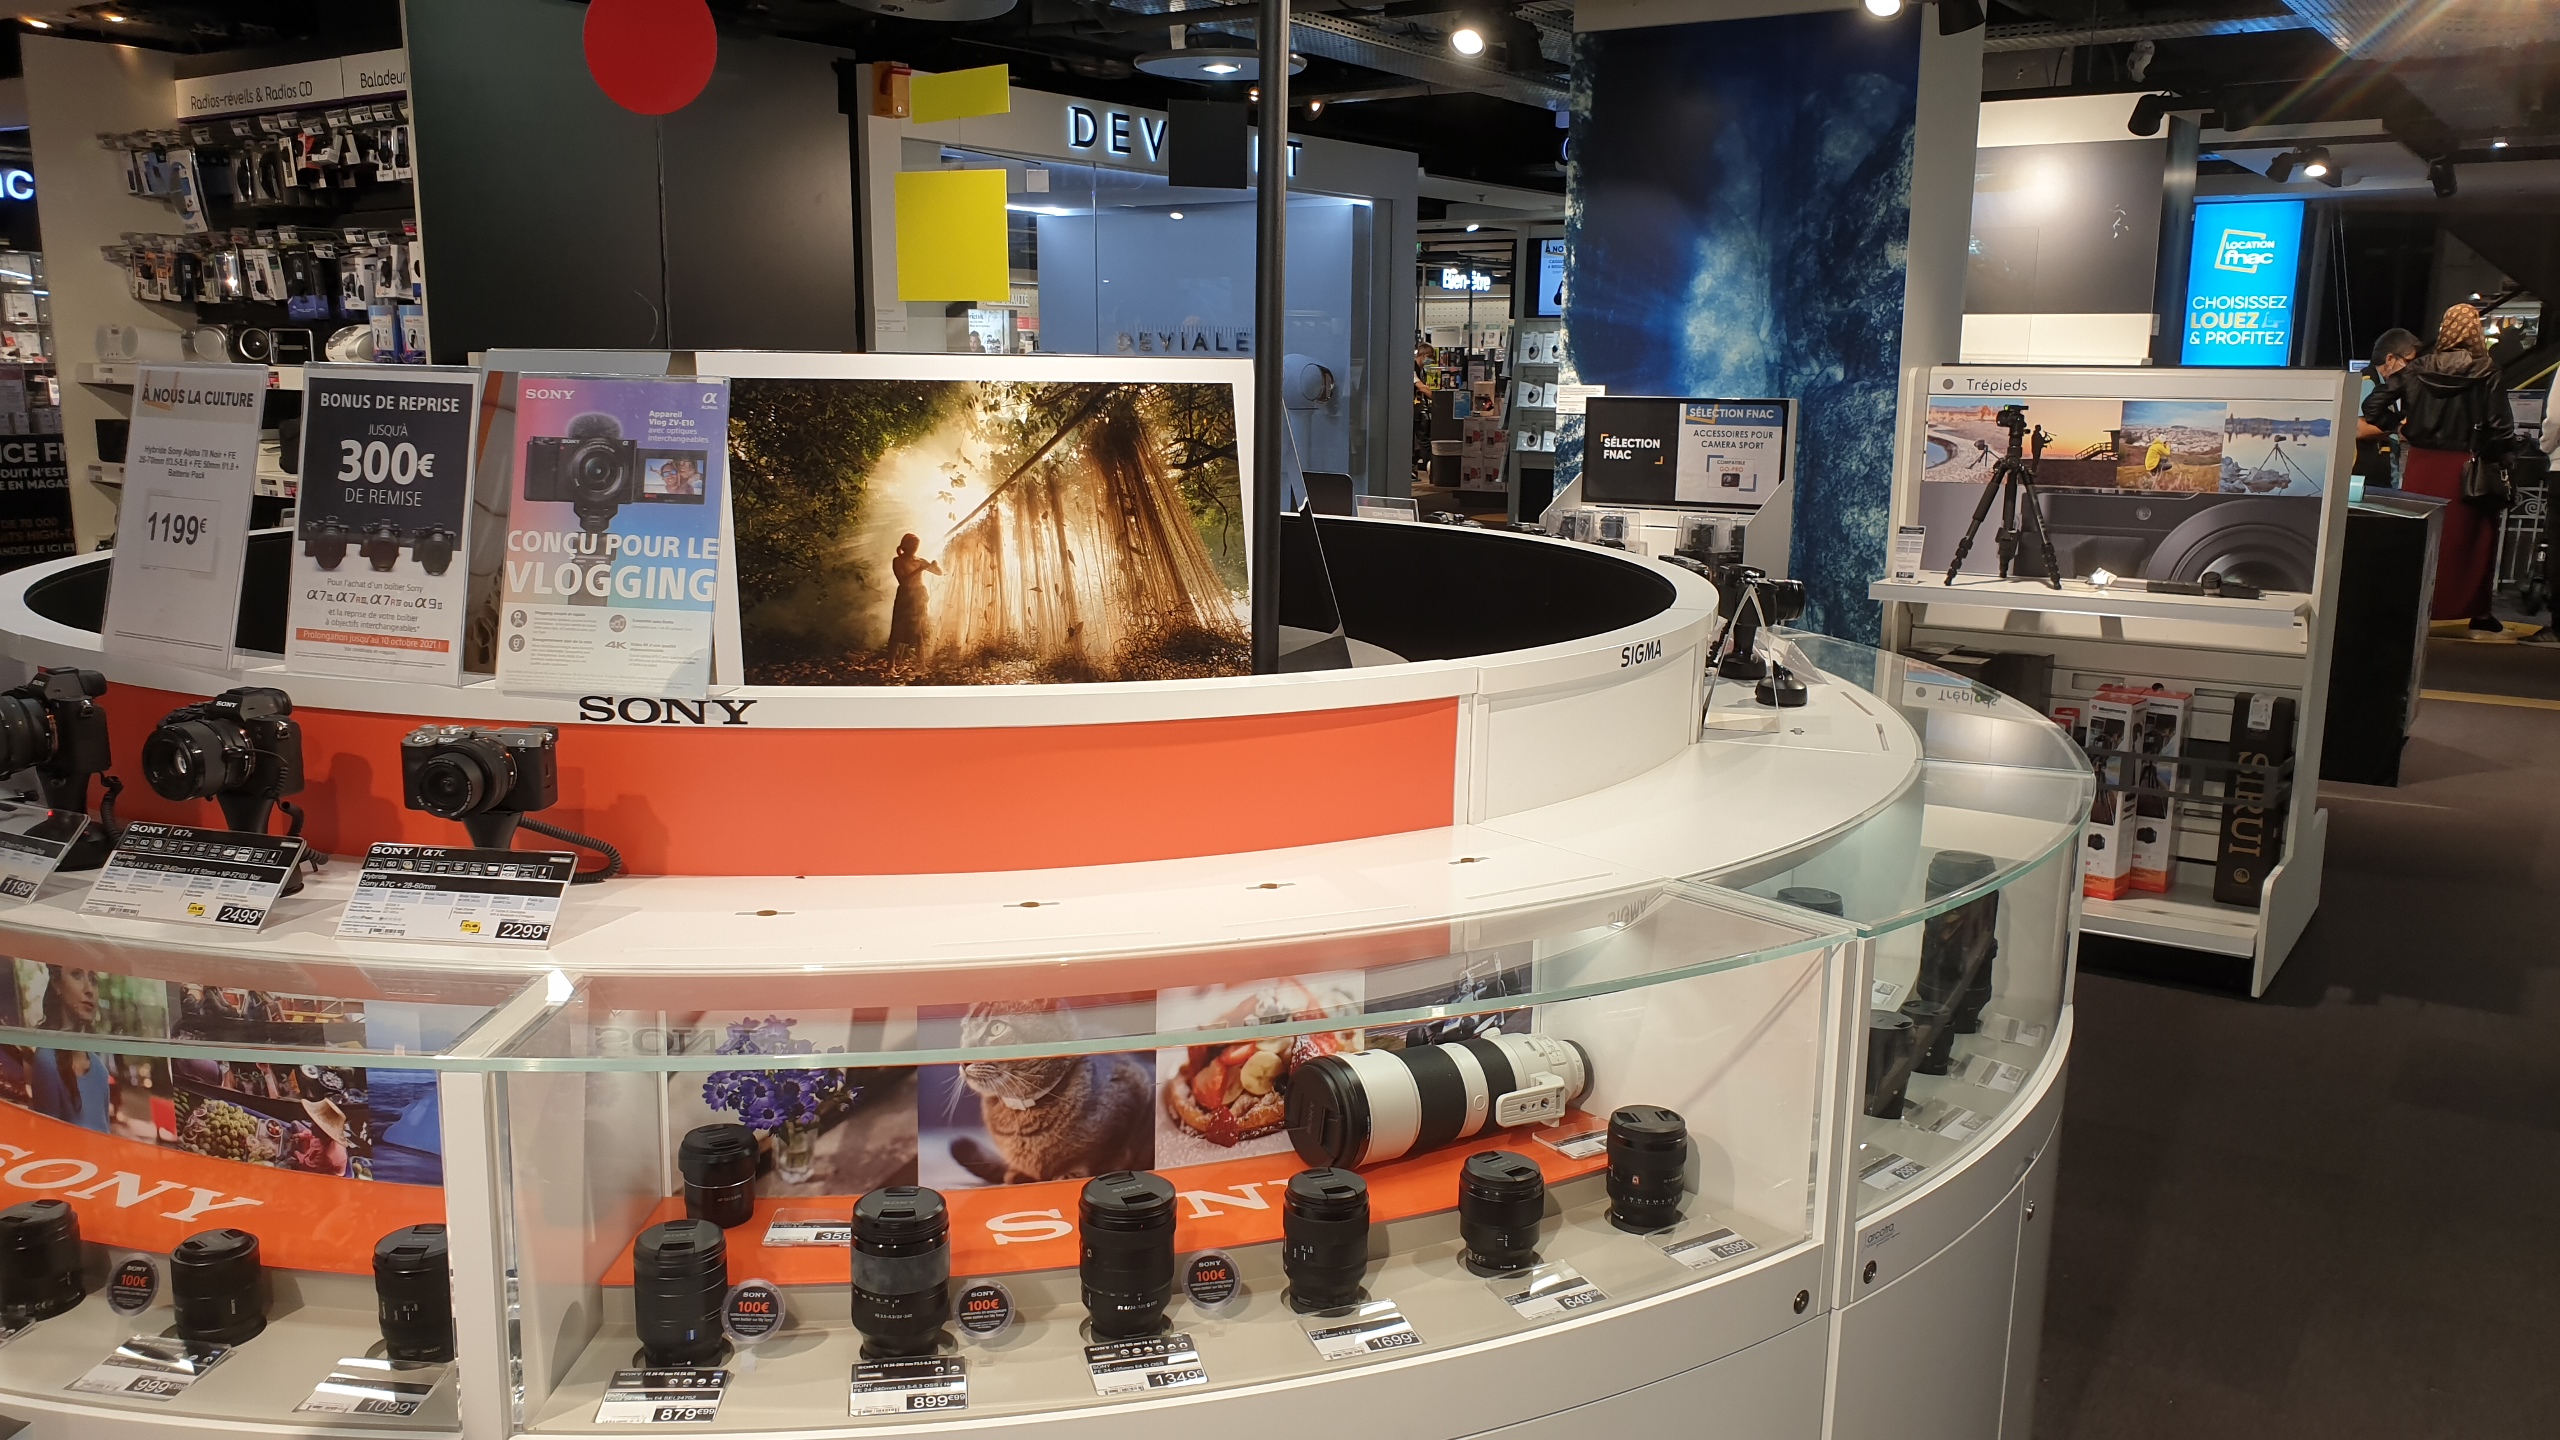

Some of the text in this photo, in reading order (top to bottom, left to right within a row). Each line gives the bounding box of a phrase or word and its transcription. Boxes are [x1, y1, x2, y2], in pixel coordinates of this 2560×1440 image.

[256, 88, 264, 103] &
[265, 85, 297, 101] Radios
[299, 81, 313, 97] CD
[2225, 240, 2275, 250] LOCATION
[2192, 296, 2287, 310] CHOISISSEZ
[2190, 312, 2260, 329] LOUEZ
[2189, 331, 2285, 345] & PROFITEZ
[1966, 378, 2028, 393] Trépieds
[153, 387, 184, 404] NOUS
[188, 389, 201, 405] LA
[204, 391, 254, 408] CULTURE
[525, 388, 576, 400] SONY
[320, 392, 460, 413] BONUS DE REPRISE
[648, 410, 682, 418] Appareil
[1690, 406, 1774, 420] SÉLECTION FNAC
[648, 418, 667, 427] Vlog
[666, 428, 698, 436] optiques
[1693, 430, 1774, 439] ACCESSOIRES POUR
[648, 434, 709, 444] interchangeables
[1604, 436, 1660, 449] SÉLECTION
[1701, 440, 1764, 450] CAMERA SPORT
[1603, 450, 1632, 460] FNAC
[337, 439, 435, 485] 300€
[8, 480, 24, 490] EN
[344, 488, 423, 507] DE REMISE
[148, 512, 208, 546] 1199€
[507, 530, 720, 560] CONÇU POUR LE
[326, 578, 343, 587] Pour
[406, 584, 424, 594] Sony
[506, 560, 718, 602] VLOGGING
[403, 600, 414, 608] ou
[368, 611, 377, 619] de
[390, 638, 418, 648] octobre
[604, 640, 628, 650] 4K
[1621, 639, 1662, 668] SIGMA
[216, 700, 238, 708] SONY
[578, 696, 758, 725] SONY
[129, 824, 168, 836] SONY
[371, 846, 414, 856] SONY
[362, 872, 388, 880] Hybride
[360, 880, 378, 888] Sony
[501, 923, 550, 938] 2299€
[1112, 1184, 1144, 1194] SONY
[1198, 1260, 1222, 1268] SONY
[122, 1274, 149, 1287] 100€
[1196, 1268, 1226, 1282] 100€
[970, 1290, 995, 1298] SONY
[738, 1300, 770, 1313] 100€
[968, 1298, 1000, 1312] 100€
[1373, 1332, 1416, 1348] 1699€
[1155, 1370, 1203, 1386] 1349€
